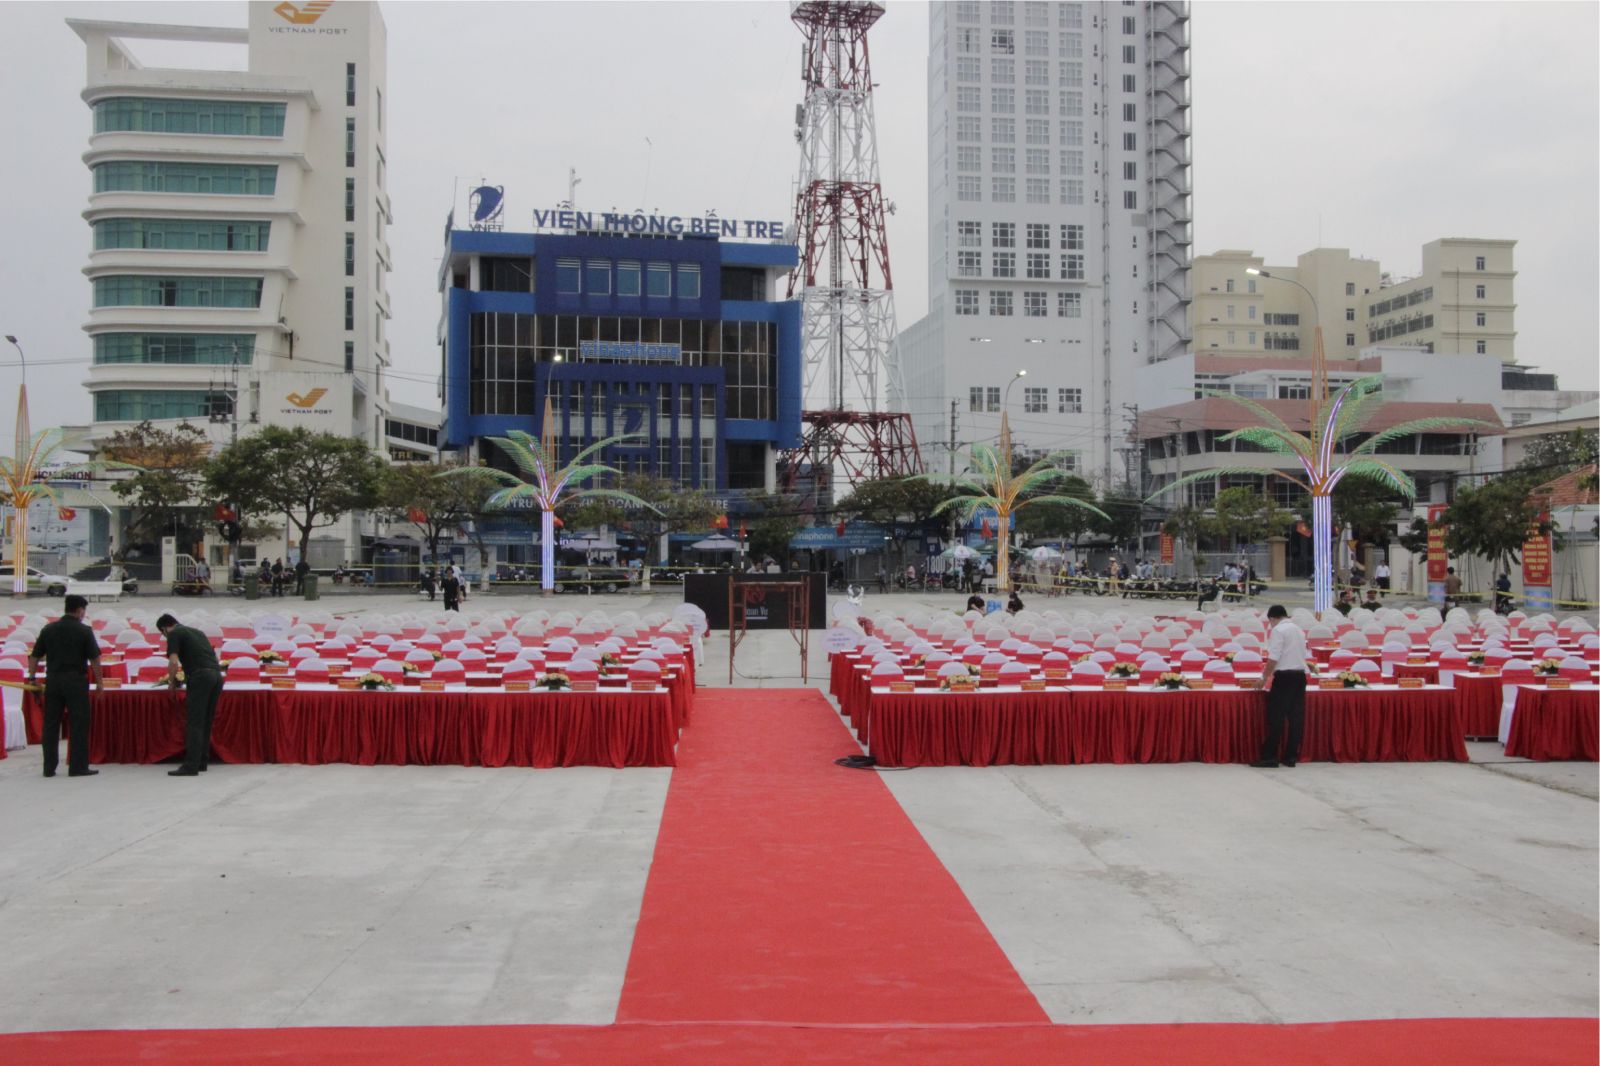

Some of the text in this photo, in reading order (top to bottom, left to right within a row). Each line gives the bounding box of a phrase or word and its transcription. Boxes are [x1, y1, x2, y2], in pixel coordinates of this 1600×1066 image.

[268, 26, 316, 34] VIETNAM
[601, 207, 684, 235] THÔNG
[690, 208, 737, 237] BẾN
[743, 219, 784, 239] TRE
